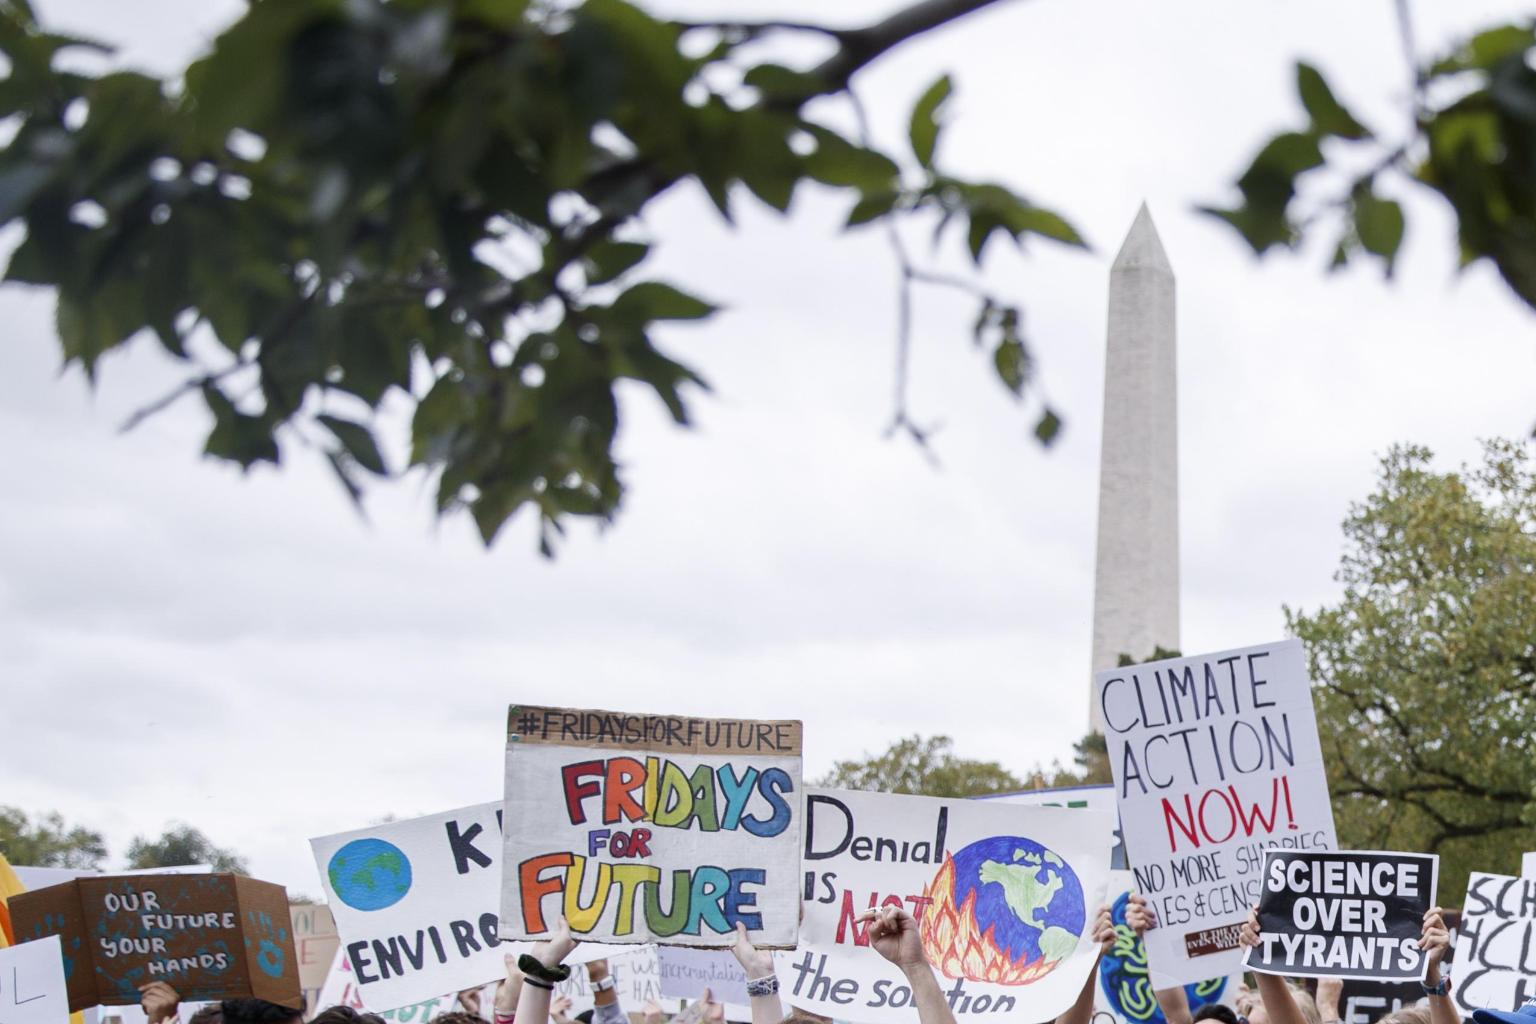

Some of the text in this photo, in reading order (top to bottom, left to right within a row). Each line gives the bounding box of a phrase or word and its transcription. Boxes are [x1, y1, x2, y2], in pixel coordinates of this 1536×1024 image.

[1102, 652, 1276, 733] CLIMATE
[517, 711, 793, 751] #FRIDAYSFORFUTURE
[1122, 713, 1294, 798] ACTION
[561, 756, 793, 837] FRIDAYS
[1161, 776, 1298, 853] NOW!
[588, 828, 652, 857] FOR
[804, 795, 948, 864] Denial
[1133, 864, 1165, 895] NO
[1170, 851, 1226, 888] MORE
[1267, 859, 1419, 897] SCIENCE
[104, 891, 160, 912] OUR
[518, 851, 766, 937] FUTURE
[142, 912, 235, 931] FUTURE
[1293, 897, 1387, 933] OVER
[101, 937, 167, 958] YOUR
[148, 953, 227, 975] HANDS
[1260, 932, 1420, 971] TYRANTS
[790, 951, 859, 1002] the
[867, 977, 1016, 1014] sotion
